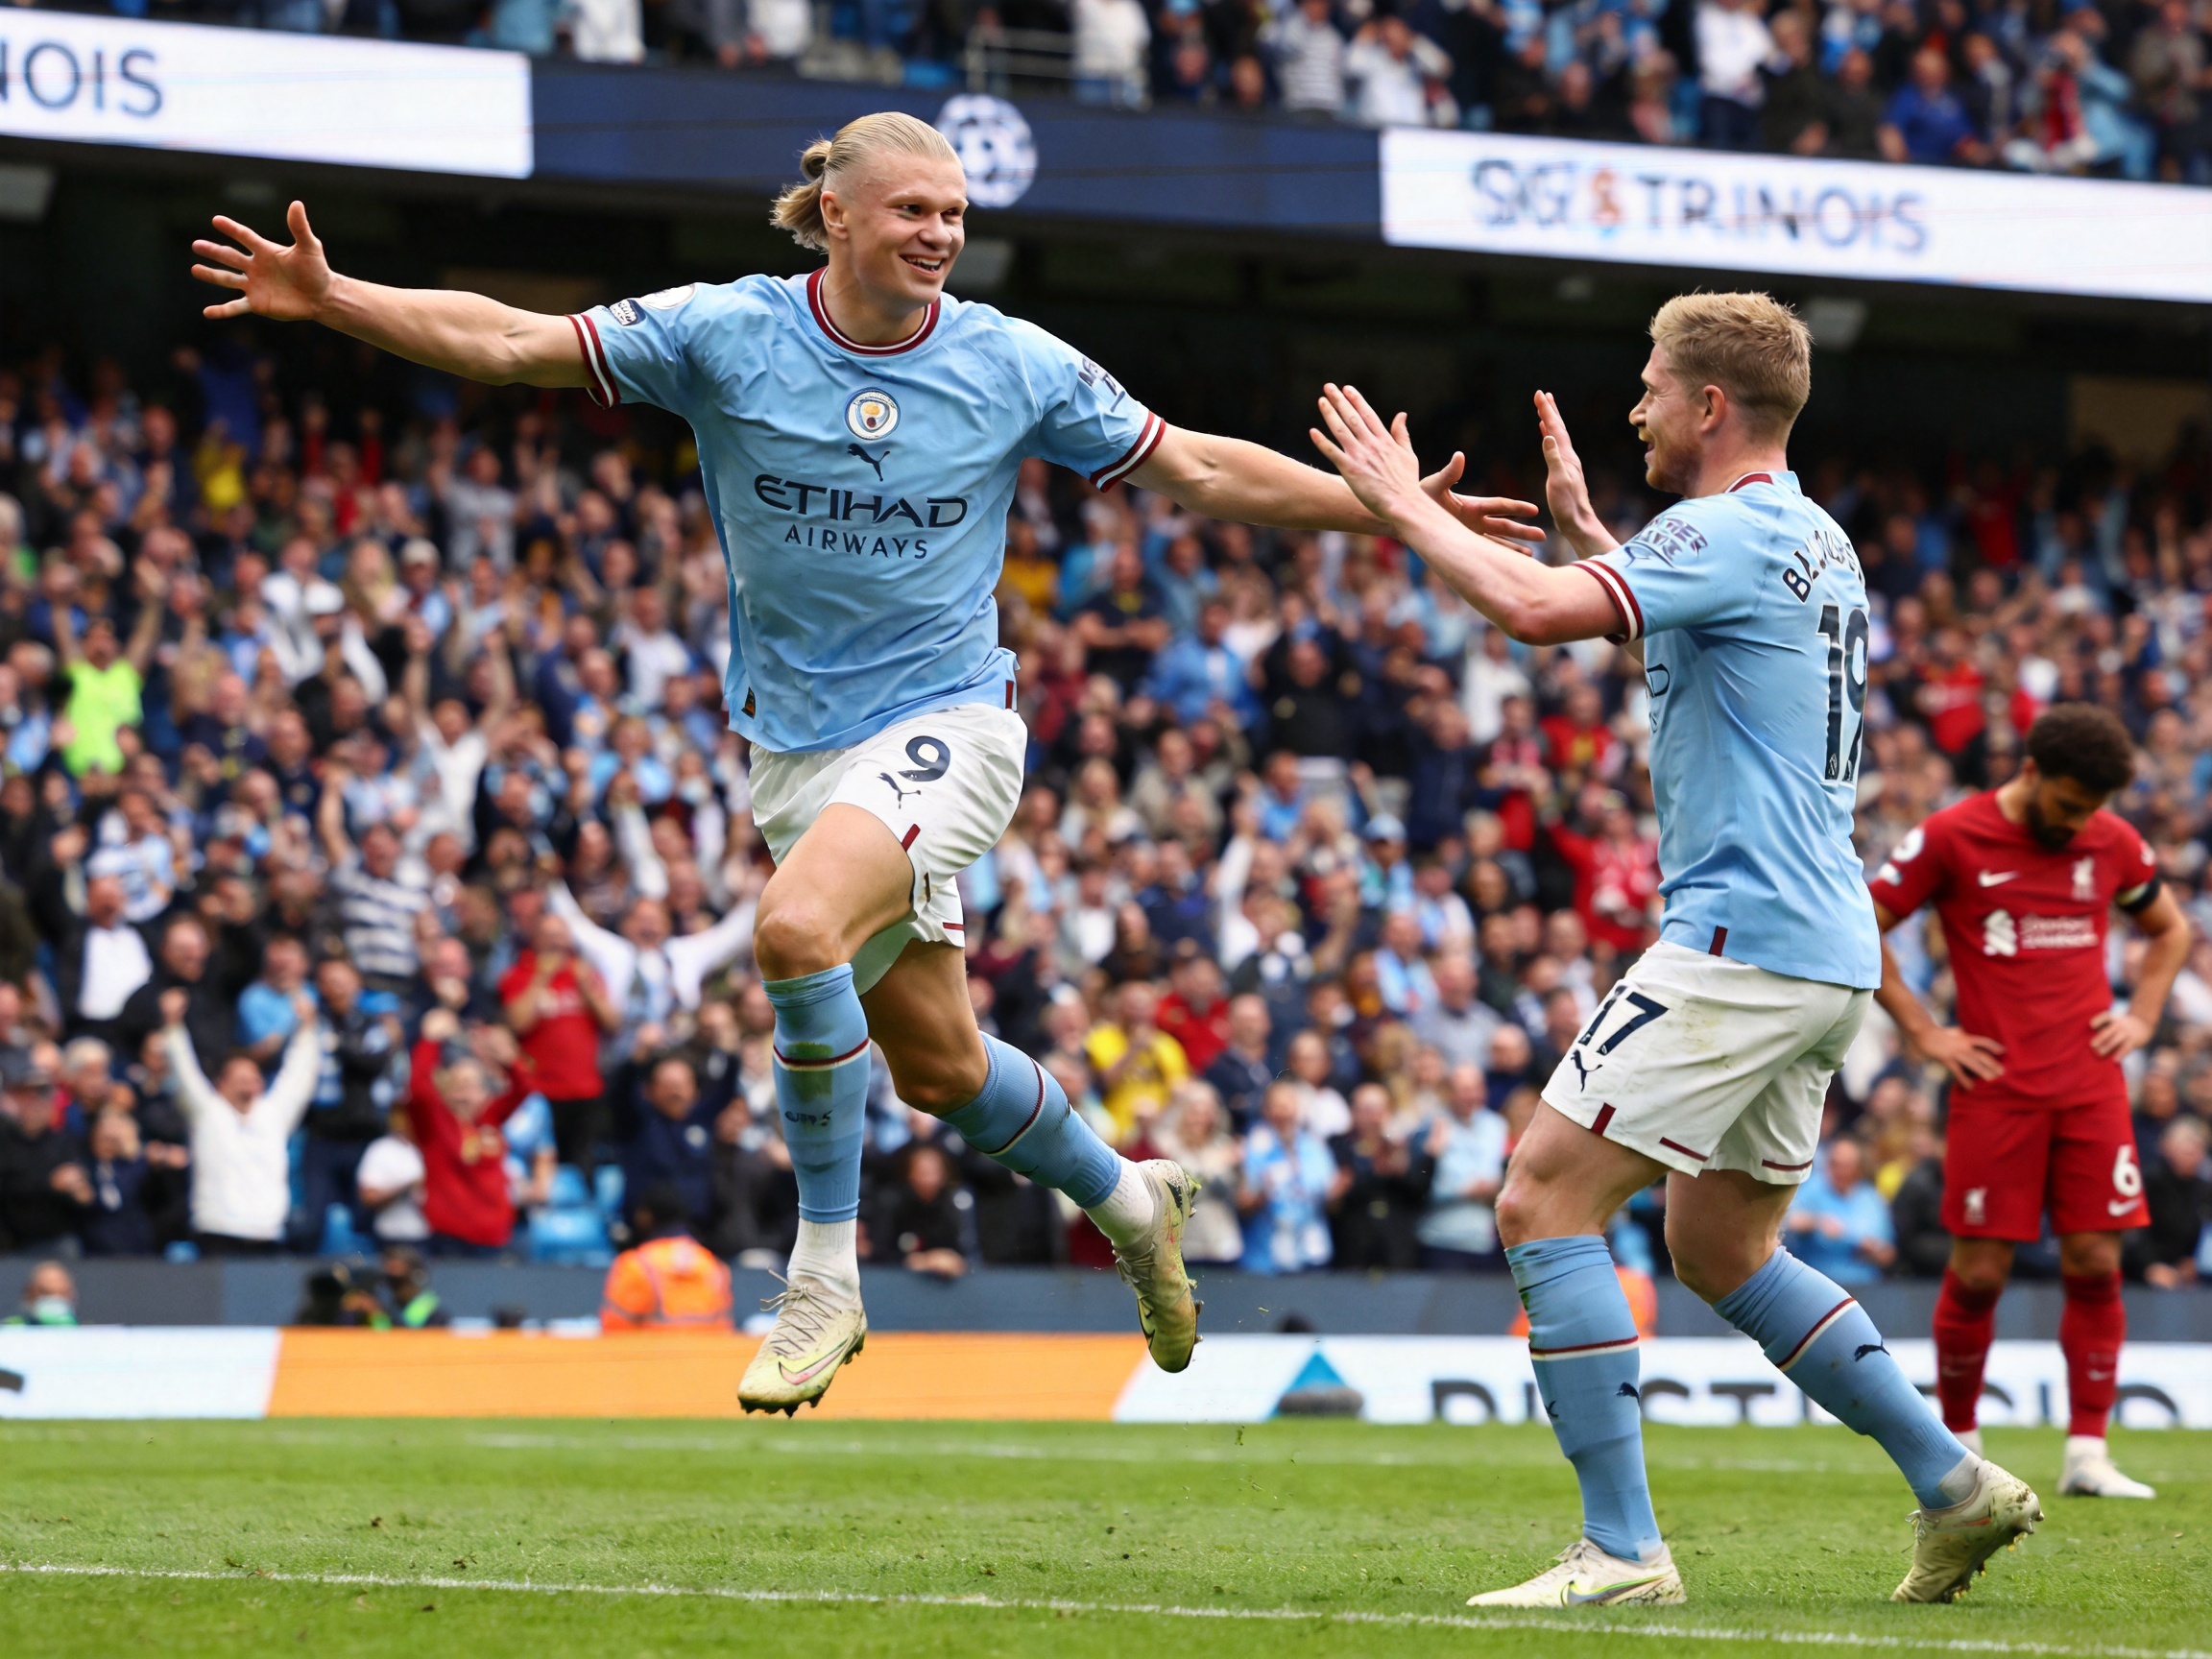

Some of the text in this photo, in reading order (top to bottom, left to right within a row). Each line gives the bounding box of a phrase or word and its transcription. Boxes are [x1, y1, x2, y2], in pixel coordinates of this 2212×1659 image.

[0, 39, 163, 118] OIS
[754, 473, 968, 528] ETIHAD
[784, 523, 927, 559] AIRWAYS
[898, 735, 950, 781] 9
[1577, 984, 1669, 1056] 17
[2113, 1143, 2142, 1198] 6
